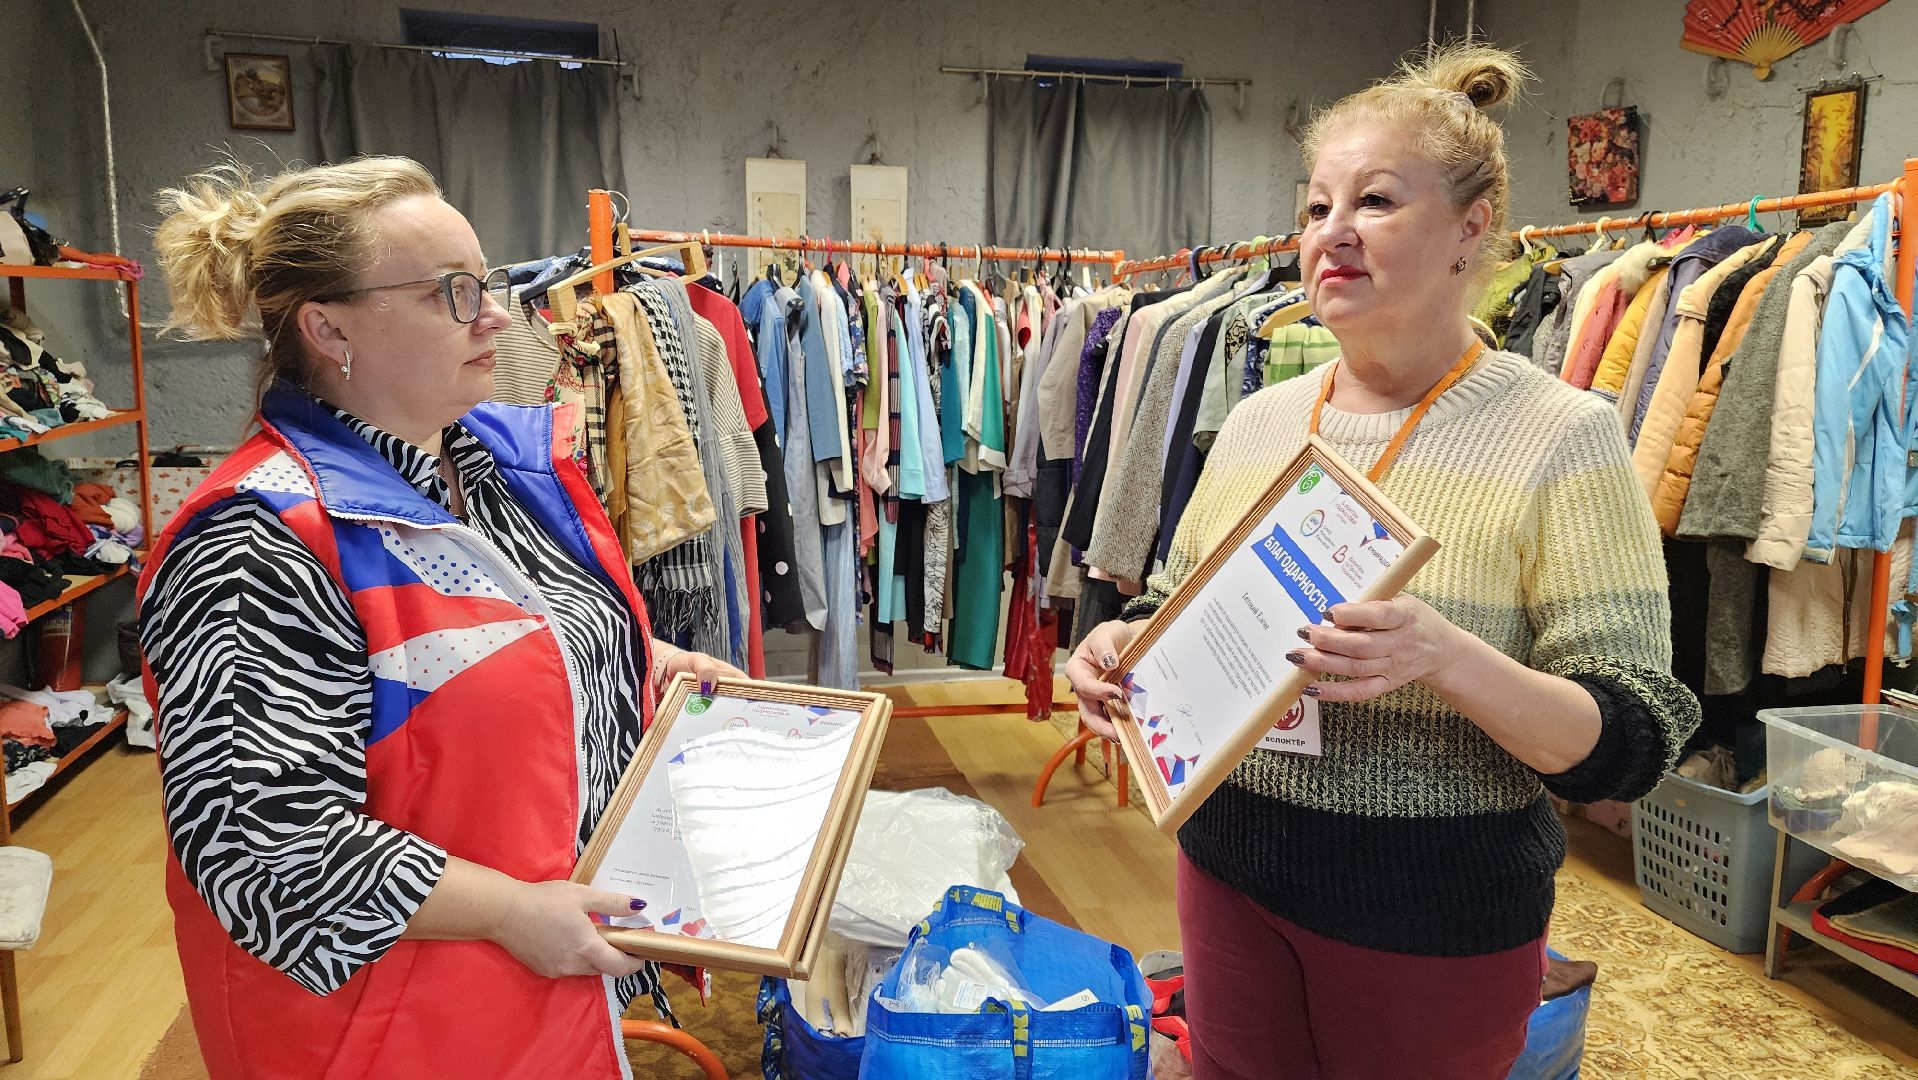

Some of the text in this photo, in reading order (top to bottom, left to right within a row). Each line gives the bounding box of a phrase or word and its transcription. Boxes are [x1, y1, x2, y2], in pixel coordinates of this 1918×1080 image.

[1263, 534, 1329, 613] БЛАГОДАРНОСТЬ
[1265, 736, 1306, 747] ВОЛОНТЁР
[1124, 1004, 1146, 1053] EA
